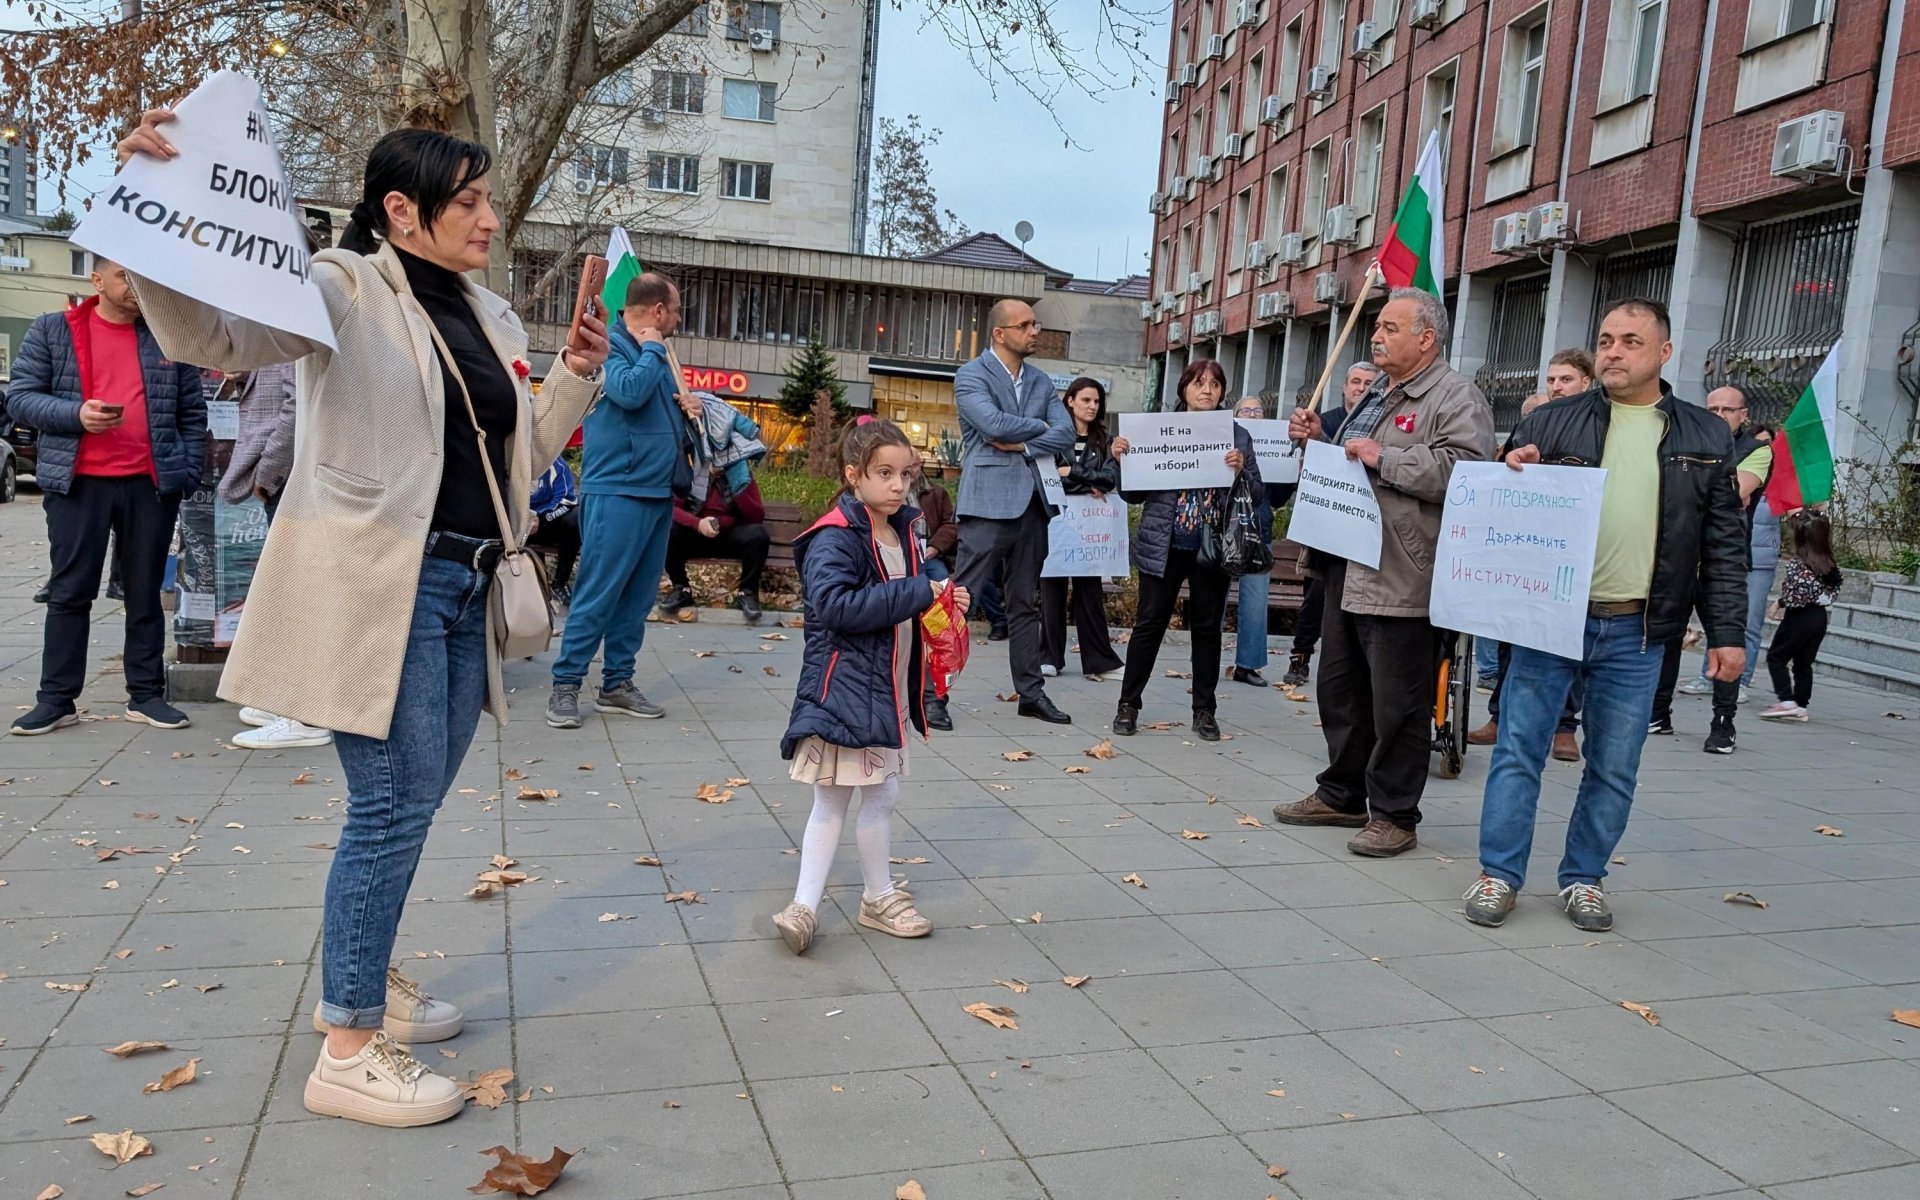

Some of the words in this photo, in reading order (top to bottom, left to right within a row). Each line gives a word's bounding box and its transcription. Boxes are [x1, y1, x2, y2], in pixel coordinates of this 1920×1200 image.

[1160, 427, 1174, 436] НЕ
[1154, 459, 1199, 470] избори!
[1301, 468, 1355, 493] Олигархията
[1300, 491, 1329, 508] решава
[1332, 502, 1365, 518] вместо
[1490, 488, 1581, 509] ПРОЗРАЧНОСТ
[1451, 525, 1467, 539] НА
[1485, 527, 1567, 550] ДЪРЖАВНИТЕ
